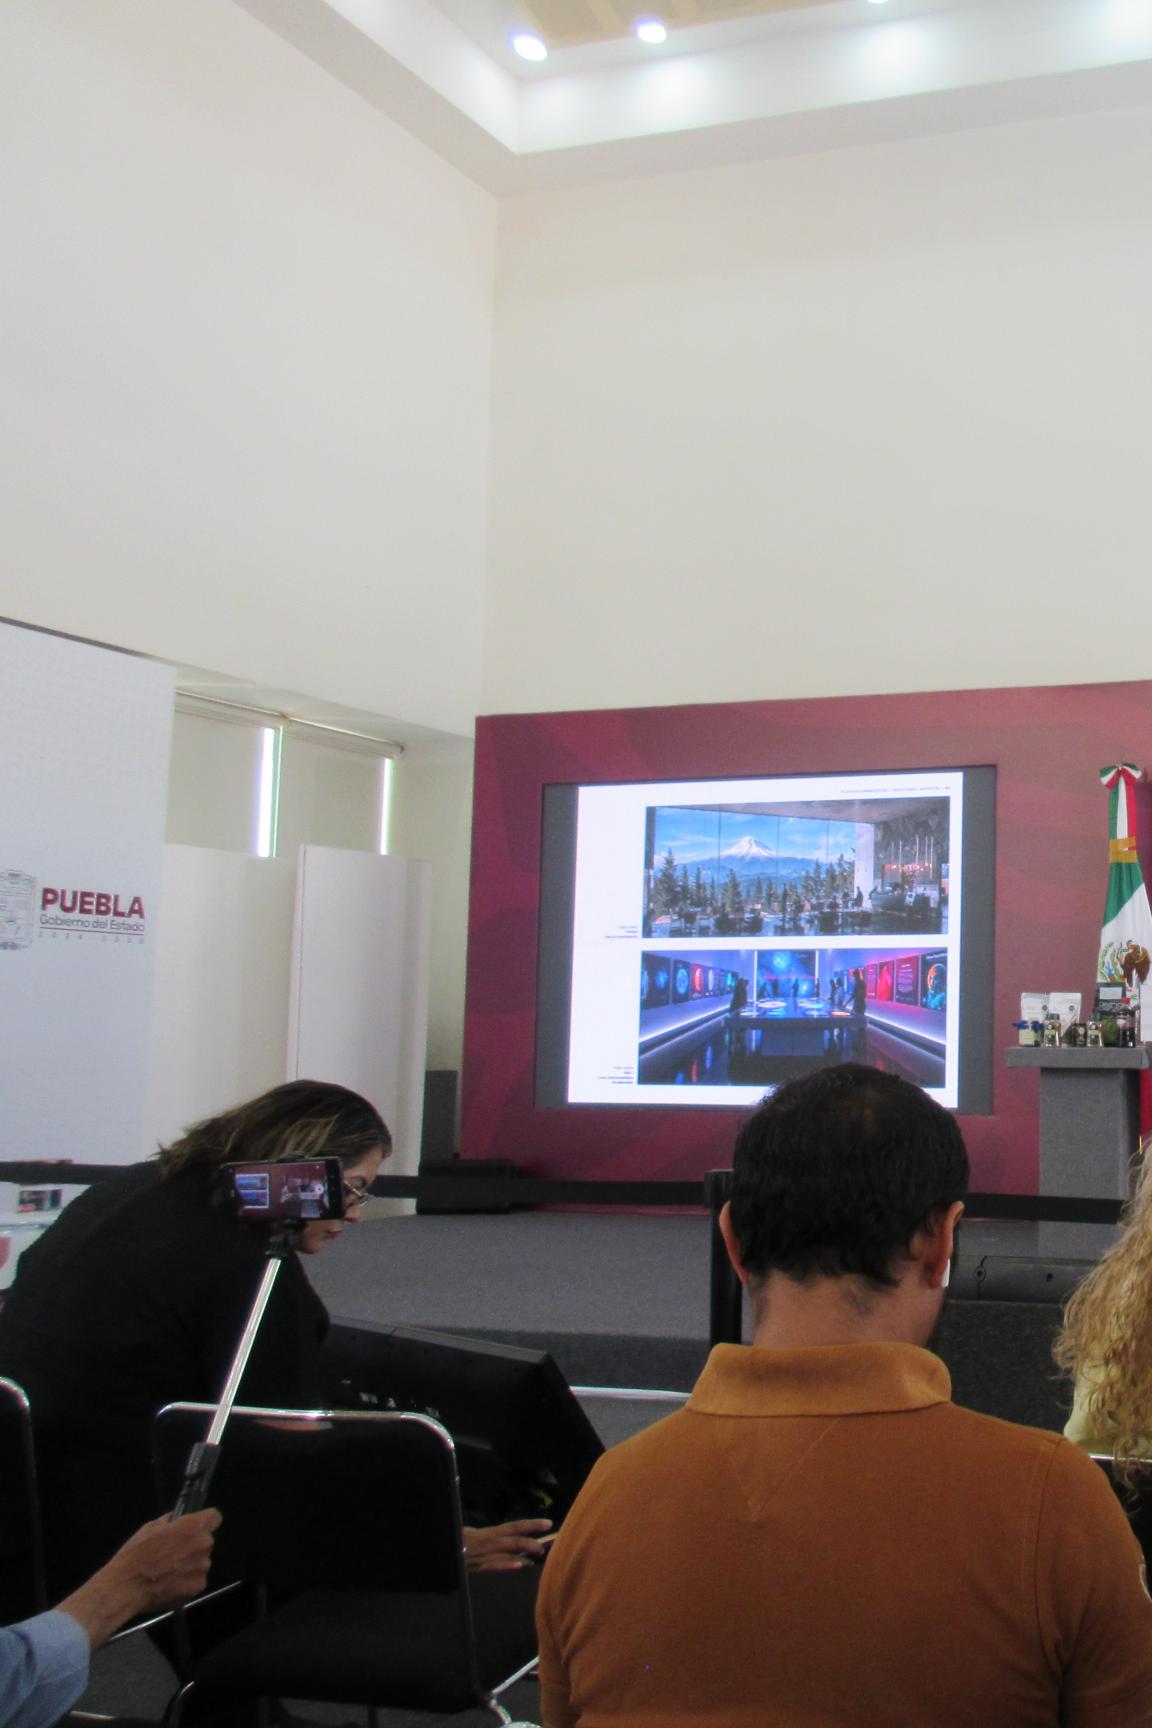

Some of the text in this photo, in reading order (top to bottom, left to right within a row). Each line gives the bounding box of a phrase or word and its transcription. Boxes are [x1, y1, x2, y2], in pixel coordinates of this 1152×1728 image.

[41, 887, 145, 919] PUEBLA
[40, 914, 145, 932] Gobierno del Estado
